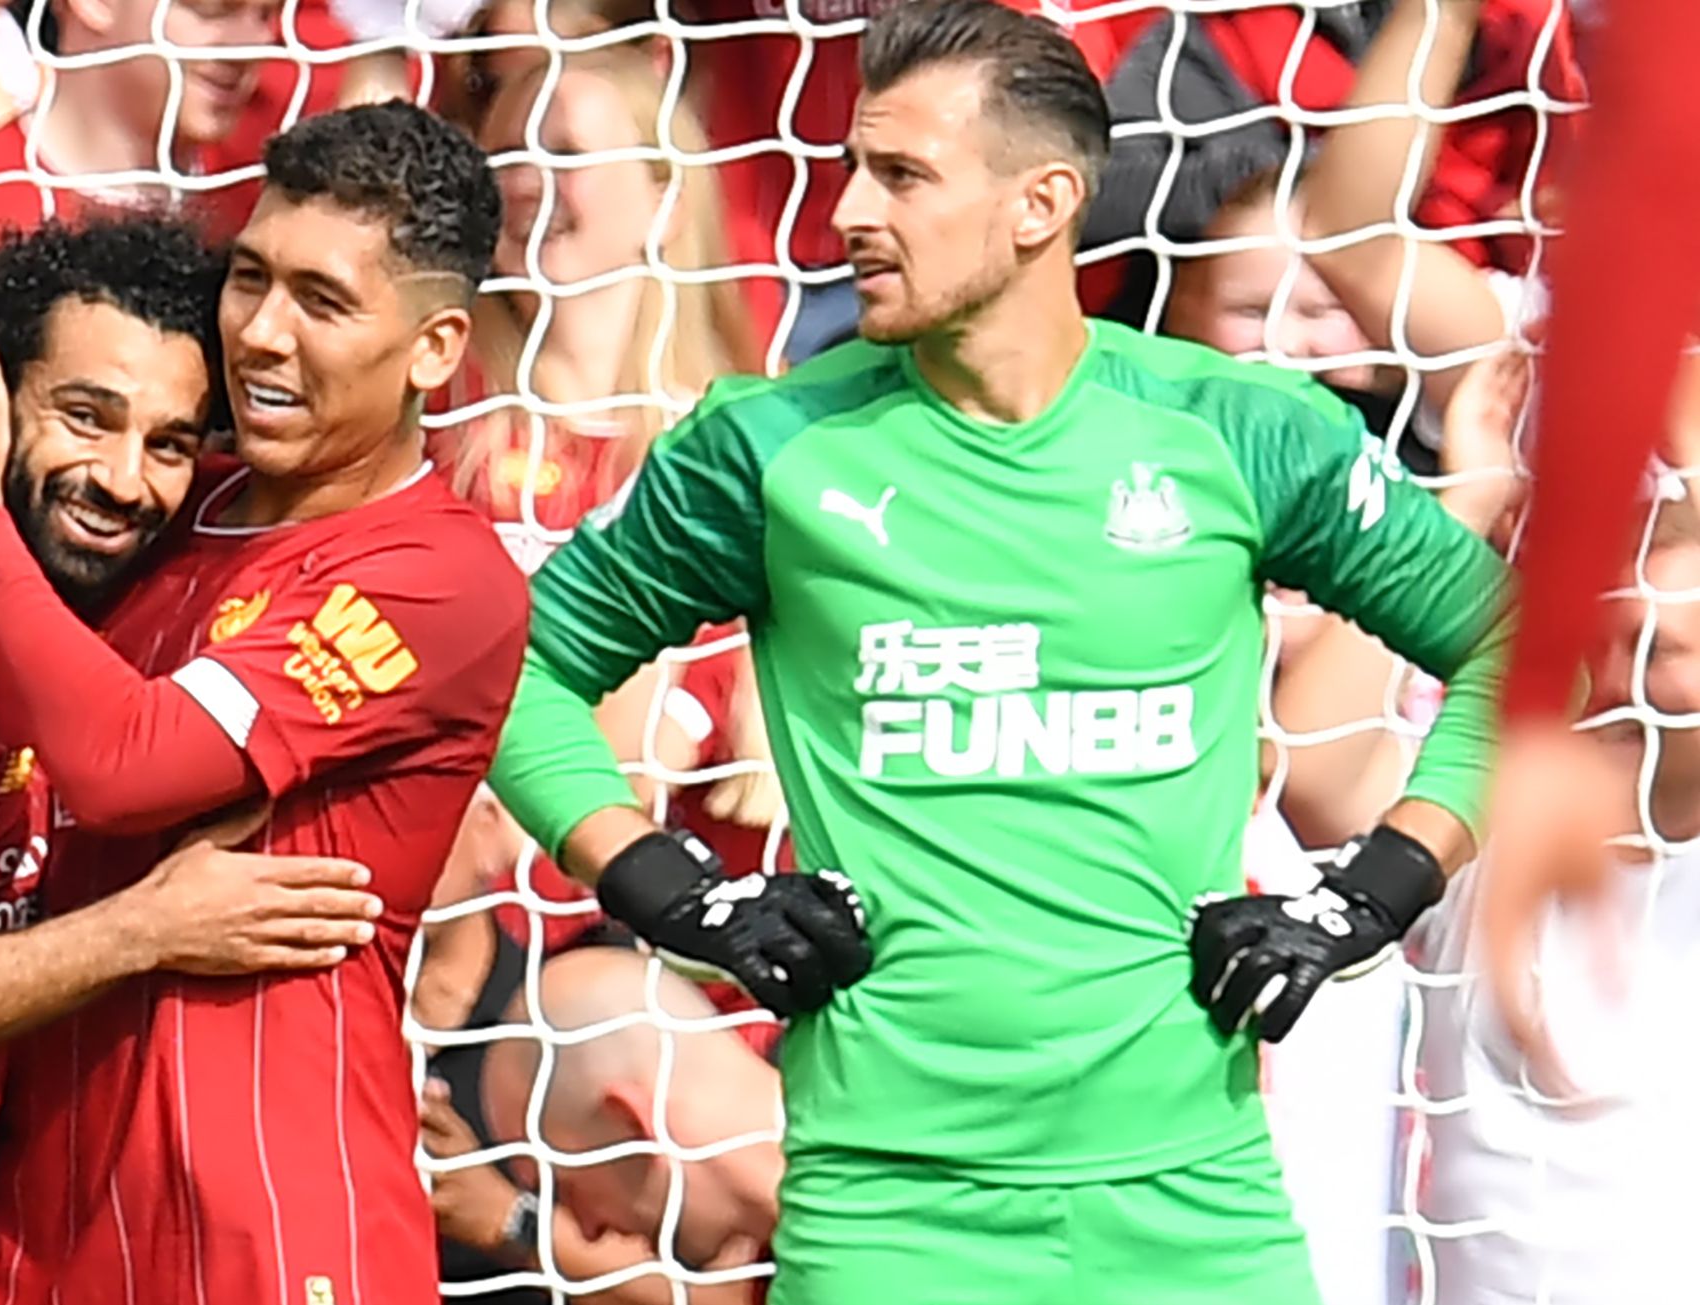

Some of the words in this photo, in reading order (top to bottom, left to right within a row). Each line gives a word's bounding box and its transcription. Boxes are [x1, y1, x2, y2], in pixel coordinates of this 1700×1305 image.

[311, 583, 419, 694] WU
[283, 651, 343, 724] Union
[859, 683, 1200, 778] FUN88
